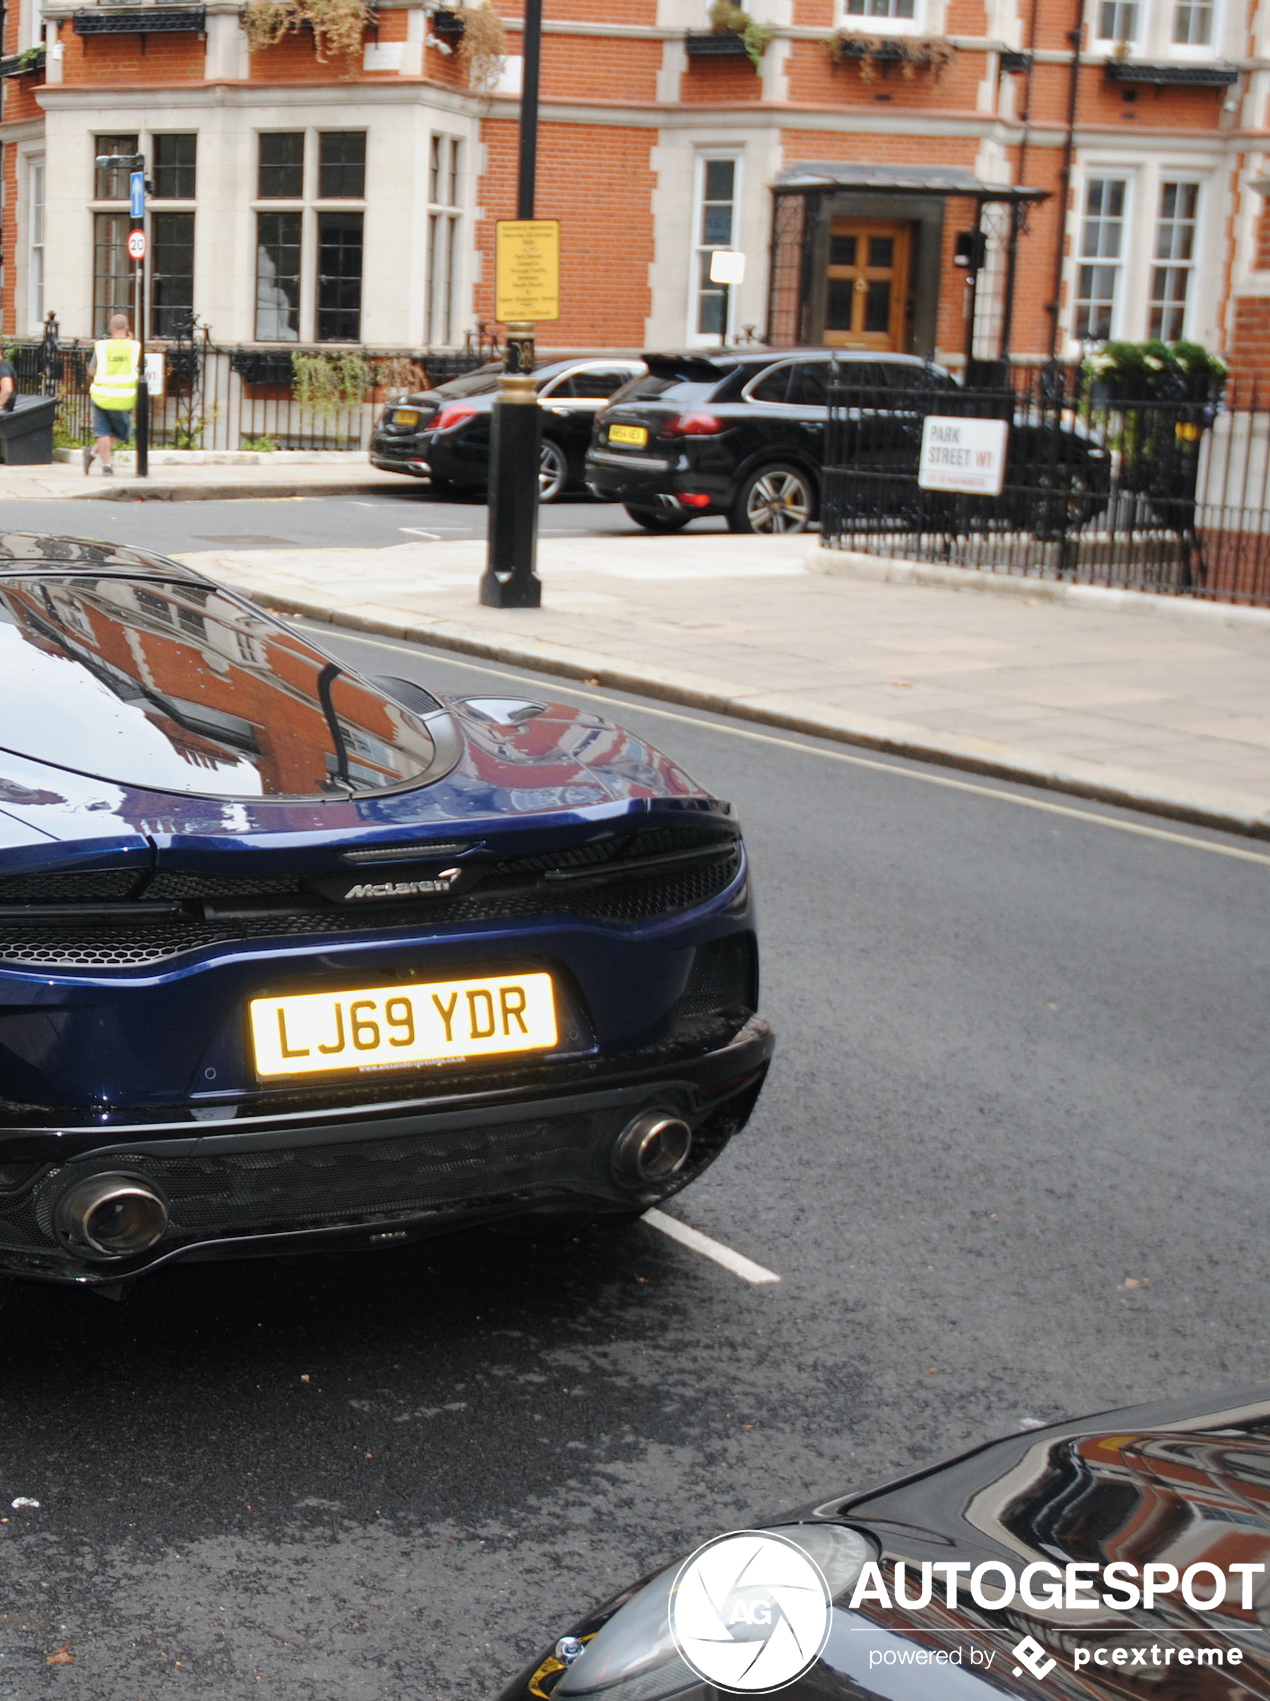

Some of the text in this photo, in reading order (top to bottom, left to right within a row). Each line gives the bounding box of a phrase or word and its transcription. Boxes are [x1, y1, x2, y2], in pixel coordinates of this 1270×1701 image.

[130, 239, 144, 251] 20
[930, 425, 960, 444] PARK
[928, 446, 992, 468] STREET W1
[345, 878, 450, 899] McLaren
[276, 986, 528, 1059] LJ69 YDR
